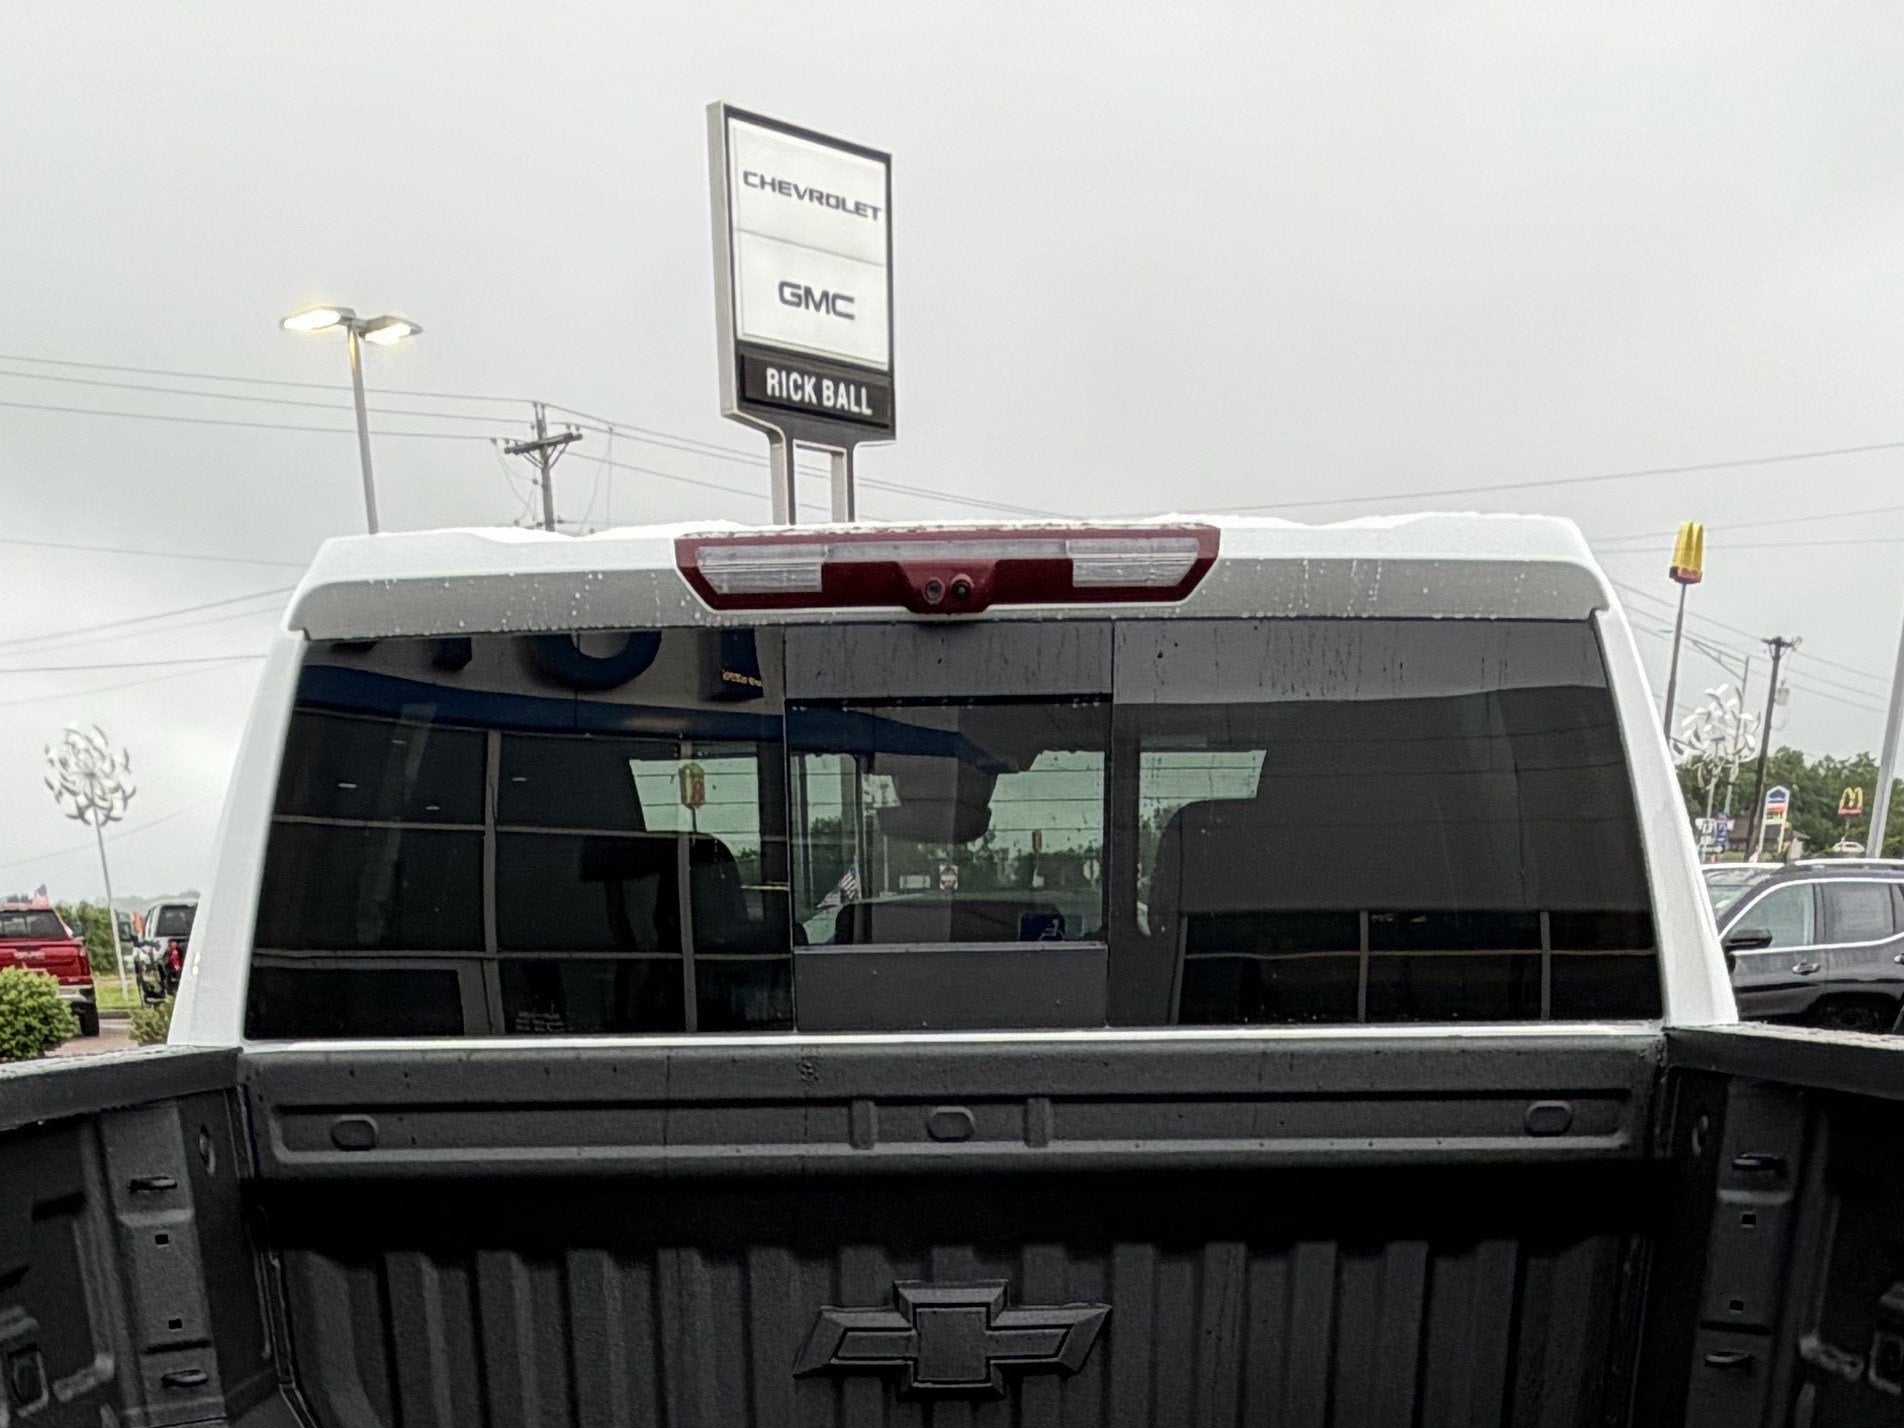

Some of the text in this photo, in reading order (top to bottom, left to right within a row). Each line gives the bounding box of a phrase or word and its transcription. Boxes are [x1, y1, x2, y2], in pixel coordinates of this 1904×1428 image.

[742, 170, 882, 222] CHEVROLET
[778, 279, 856, 320] GMC
[765, 366, 873, 416] RICK BALL
